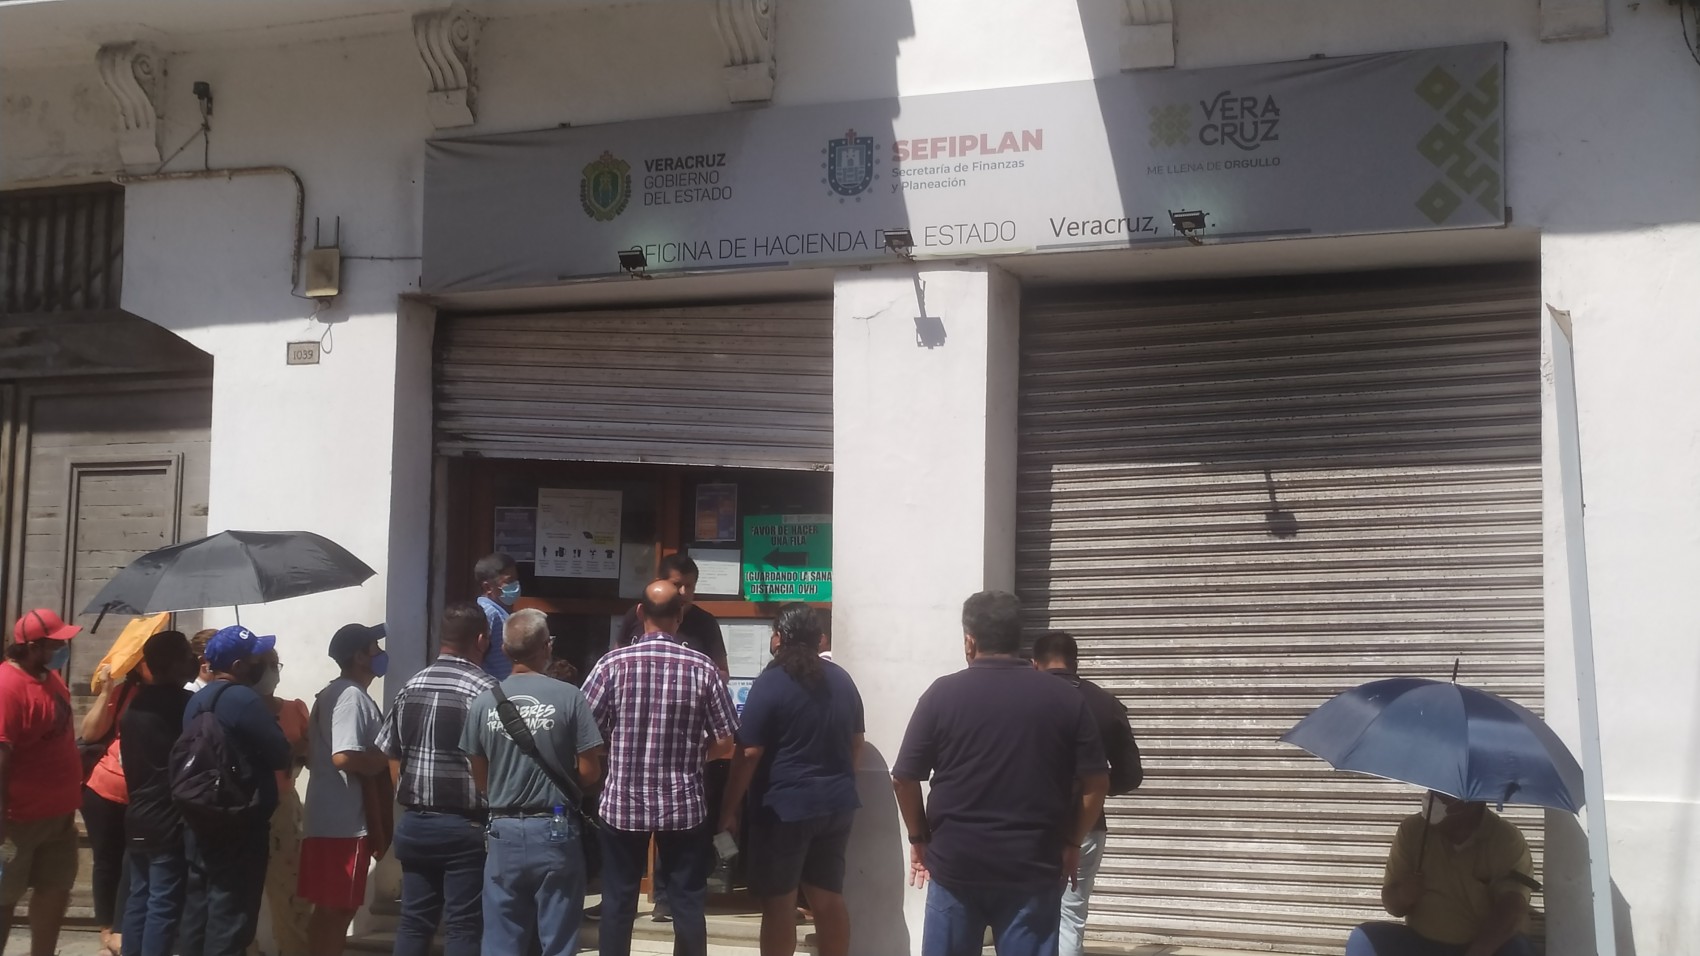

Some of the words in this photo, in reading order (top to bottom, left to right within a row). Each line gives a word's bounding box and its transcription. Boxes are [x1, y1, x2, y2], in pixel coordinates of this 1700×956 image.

[1200, 90, 1280, 121] VERA
[1199, 119, 1280, 151] CRUZ
[892, 129, 1043, 162] SEFIPLAN
[644, 153, 726, 173] VERACRUZ
[892, 163, 951, 178] Secretaría
[953, 162, 969, 173] de
[972, 158, 1025, 172] Finanzas
[1147, 165, 1164, 175] ME
[1167, 161, 1204, 174] LLENA
[1206, 160, 1221, 171] DE
[1224, 157, 1281, 170] ORGULLO
[644, 170, 720, 190] GOBIERNO
[891, 182, 899, 194] y
[901, 177, 966, 191] Planeación
[644, 191, 671, 206] DEL
[675, 186, 732, 204] ESTADO
[719, 238, 747, 259] DE
[753, 230, 869, 257] HACIENDA
[924, 220, 1016, 247] ESTADO
[1050, 214, 1159, 238] Veracruz,
[293, 350, 314, 360] 1039
[800, 571, 809, 582] LA
[810, 571, 832, 582] SANA
[750, 584, 794, 595] DISTANCIA
[487, 704, 556, 721] HBRES
